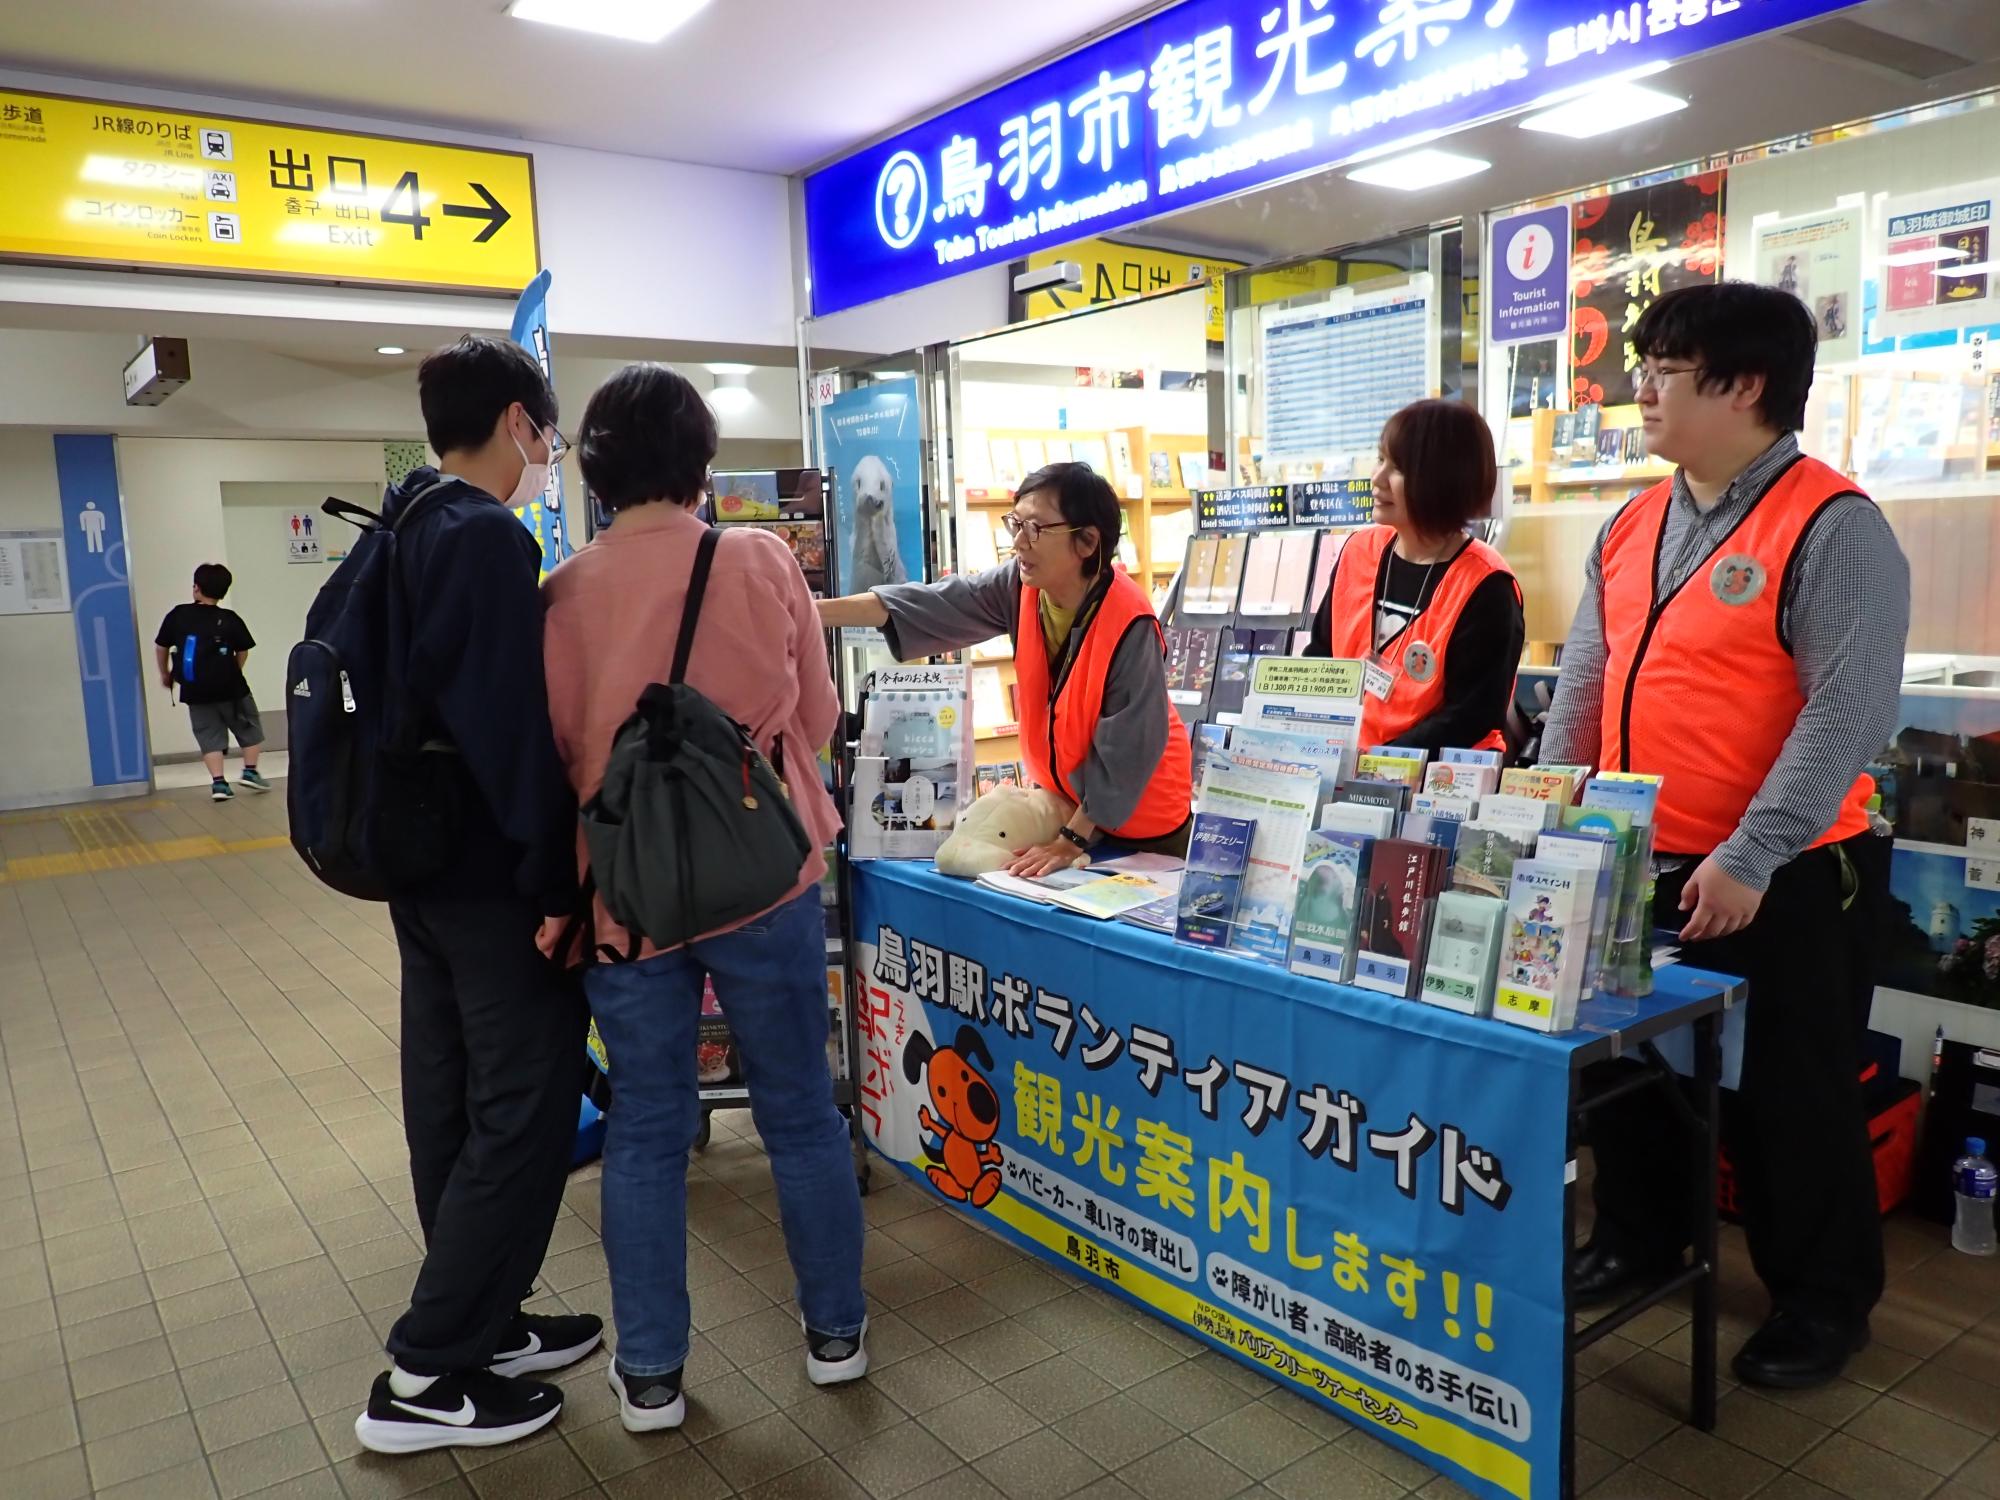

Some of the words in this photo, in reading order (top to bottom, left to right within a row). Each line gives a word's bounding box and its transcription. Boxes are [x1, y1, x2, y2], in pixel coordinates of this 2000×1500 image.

[0, 104, 44, 124] 歩道
[931, 0, 1514, 221] 鳥羽市観光案
[92, 115, 192, 140] JR線のりば
[122, 161, 196, 179] タクシー
[268, 148, 367, 196] 出口
[380, 170, 431, 241] 4
[85, 200, 201, 222] コインロッカー
[284, 196, 321, 216] 출구
[335, 203, 371, 220] 出口
[934, 235, 976, 265] Toba
[975, 211, 1038, 252] Tourist
[1037, 179, 1148, 234] Information
[1890, 204, 1988, 236] 鳥羽城御城印
[147, 231, 168, 241] Coin
[169, 234, 203, 243] Lockers
[327, 225, 374, 248] Exit
[1512, 287, 1547, 302] Tourist
[1499, 300, 1560, 318] Information
[1201, 520, 1217, 528] Hotel
[1218, 519, 1242, 528] Shuttle
[1244, 518, 1256, 526] Bus
[1257, 515, 1287, 526] Schedule
[1296, 514, 1329, 524] Boarding
[1348, 512, 1354, 521] is
[1356, 513, 1364, 521] at
[1349, 793, 1390, 806] MIKIMOTO
[1194, 831, 1245, 846] 伊勢湾フェリー
[1516, 873, 1571, 890] 志摩スペイン村
[1398, 853, 1418, 932] 江戸川乱歩館
[1302, 949, 1332, 965] 鳥羽
[1366, 963, 1397, 979] 鳥羽
[1425, 975, 1475, 1000] 伊勢・二見
[1507, 993, 1541, 1013] 志摩
[873, 925, 1512, 1216] 鳥羽駅ボランティアガイド
[1012, 1060, 1495, 1353] 観光案内します!!
[1018, 1167, 1193, 1274] ベビーカー・車いすの貸出し
[1066, 1235, 1121, 1281] 鳥羽市
[1231, 1270, 1519, 1429] 障がい者・高齢者のお手伝い
